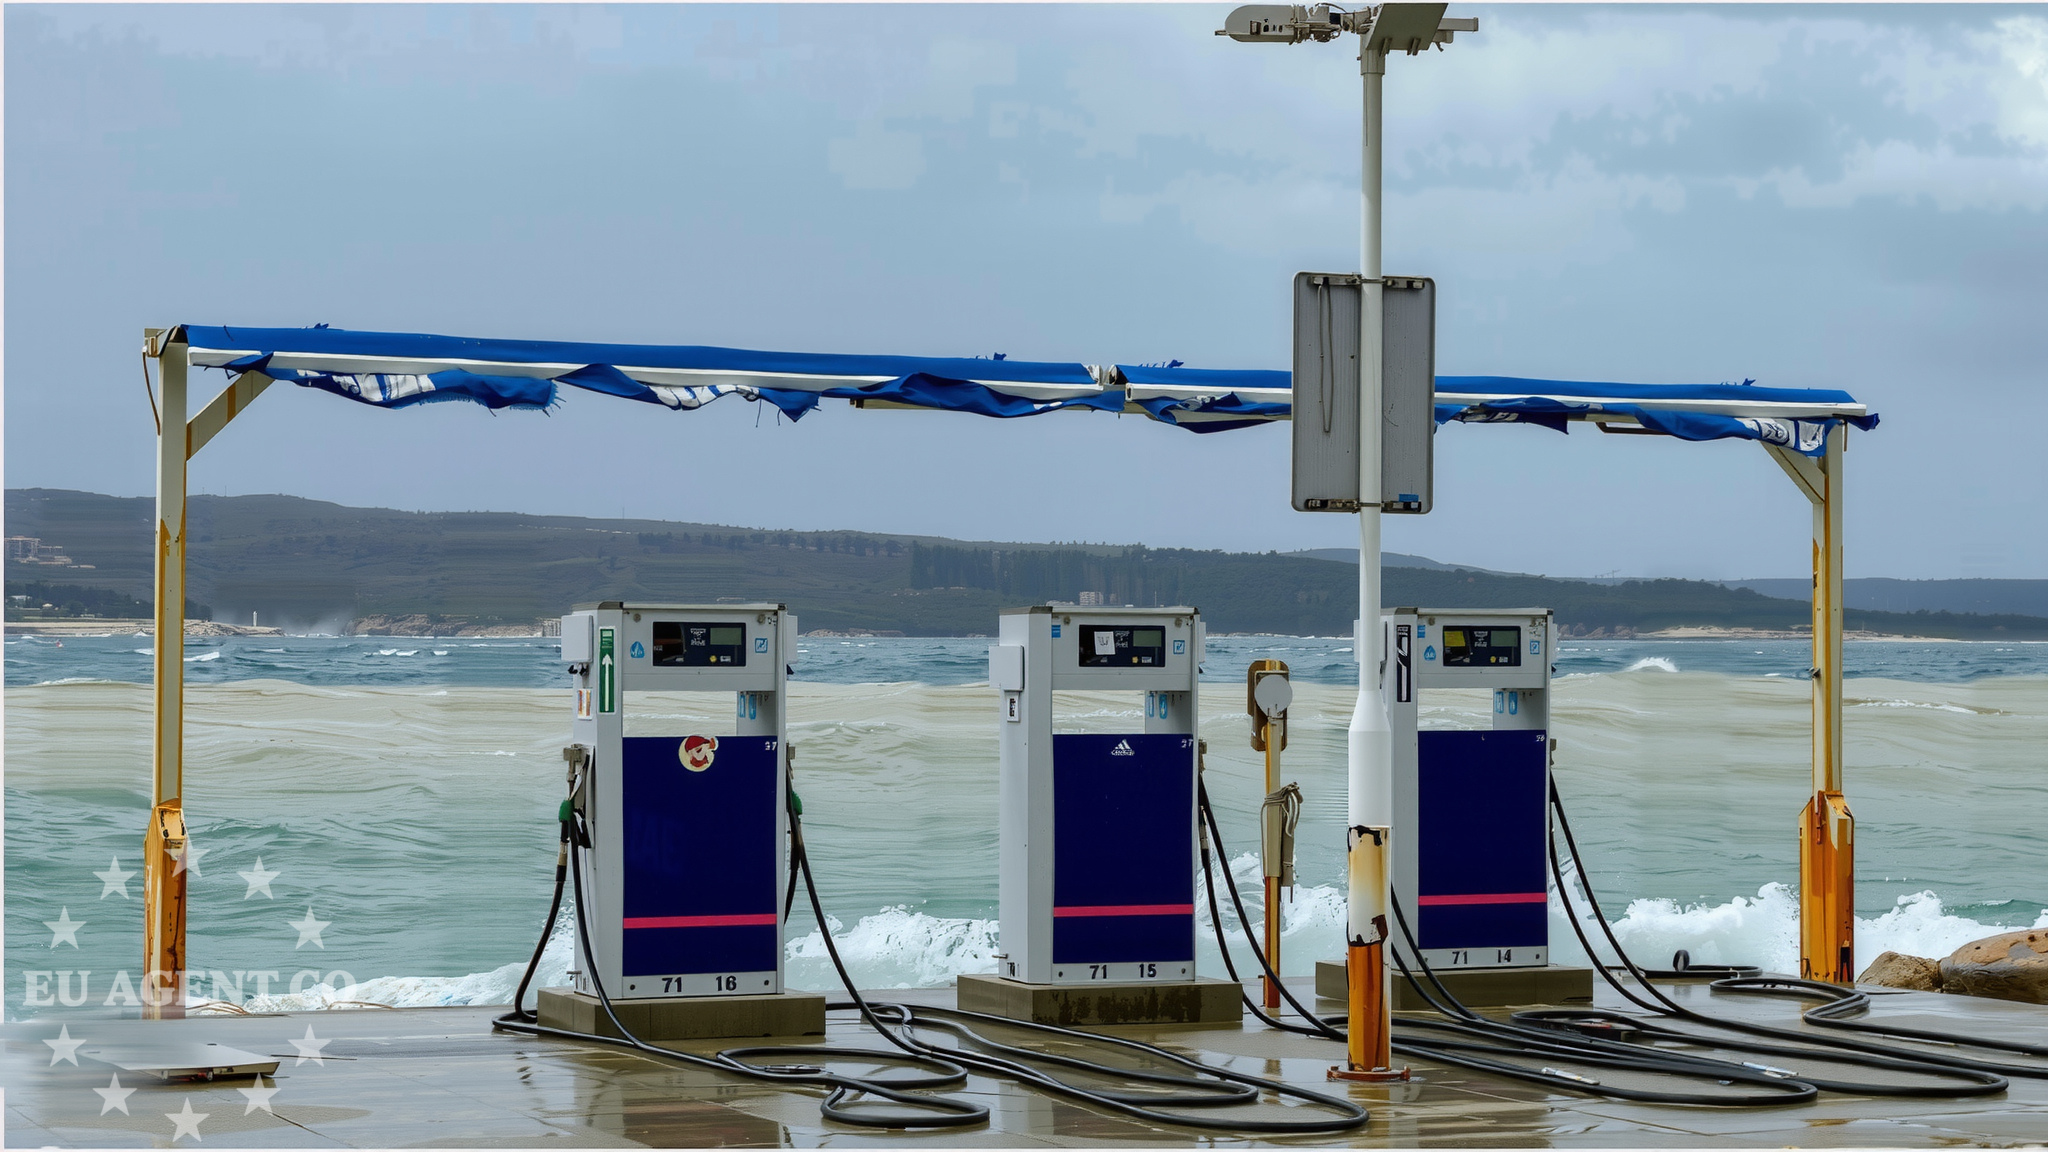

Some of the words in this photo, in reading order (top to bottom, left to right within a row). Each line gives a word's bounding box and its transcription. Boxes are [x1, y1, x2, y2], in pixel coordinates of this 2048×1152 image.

[1452, 951, 1468, 965] 71
[1497, 949, 1512, 963] 14
[1089, 964, 1108, 979] 71
[1139, 963, 1157, 978] 15
[661, 977, 682, 993] 71
[716, 975, 737, 992] 16
